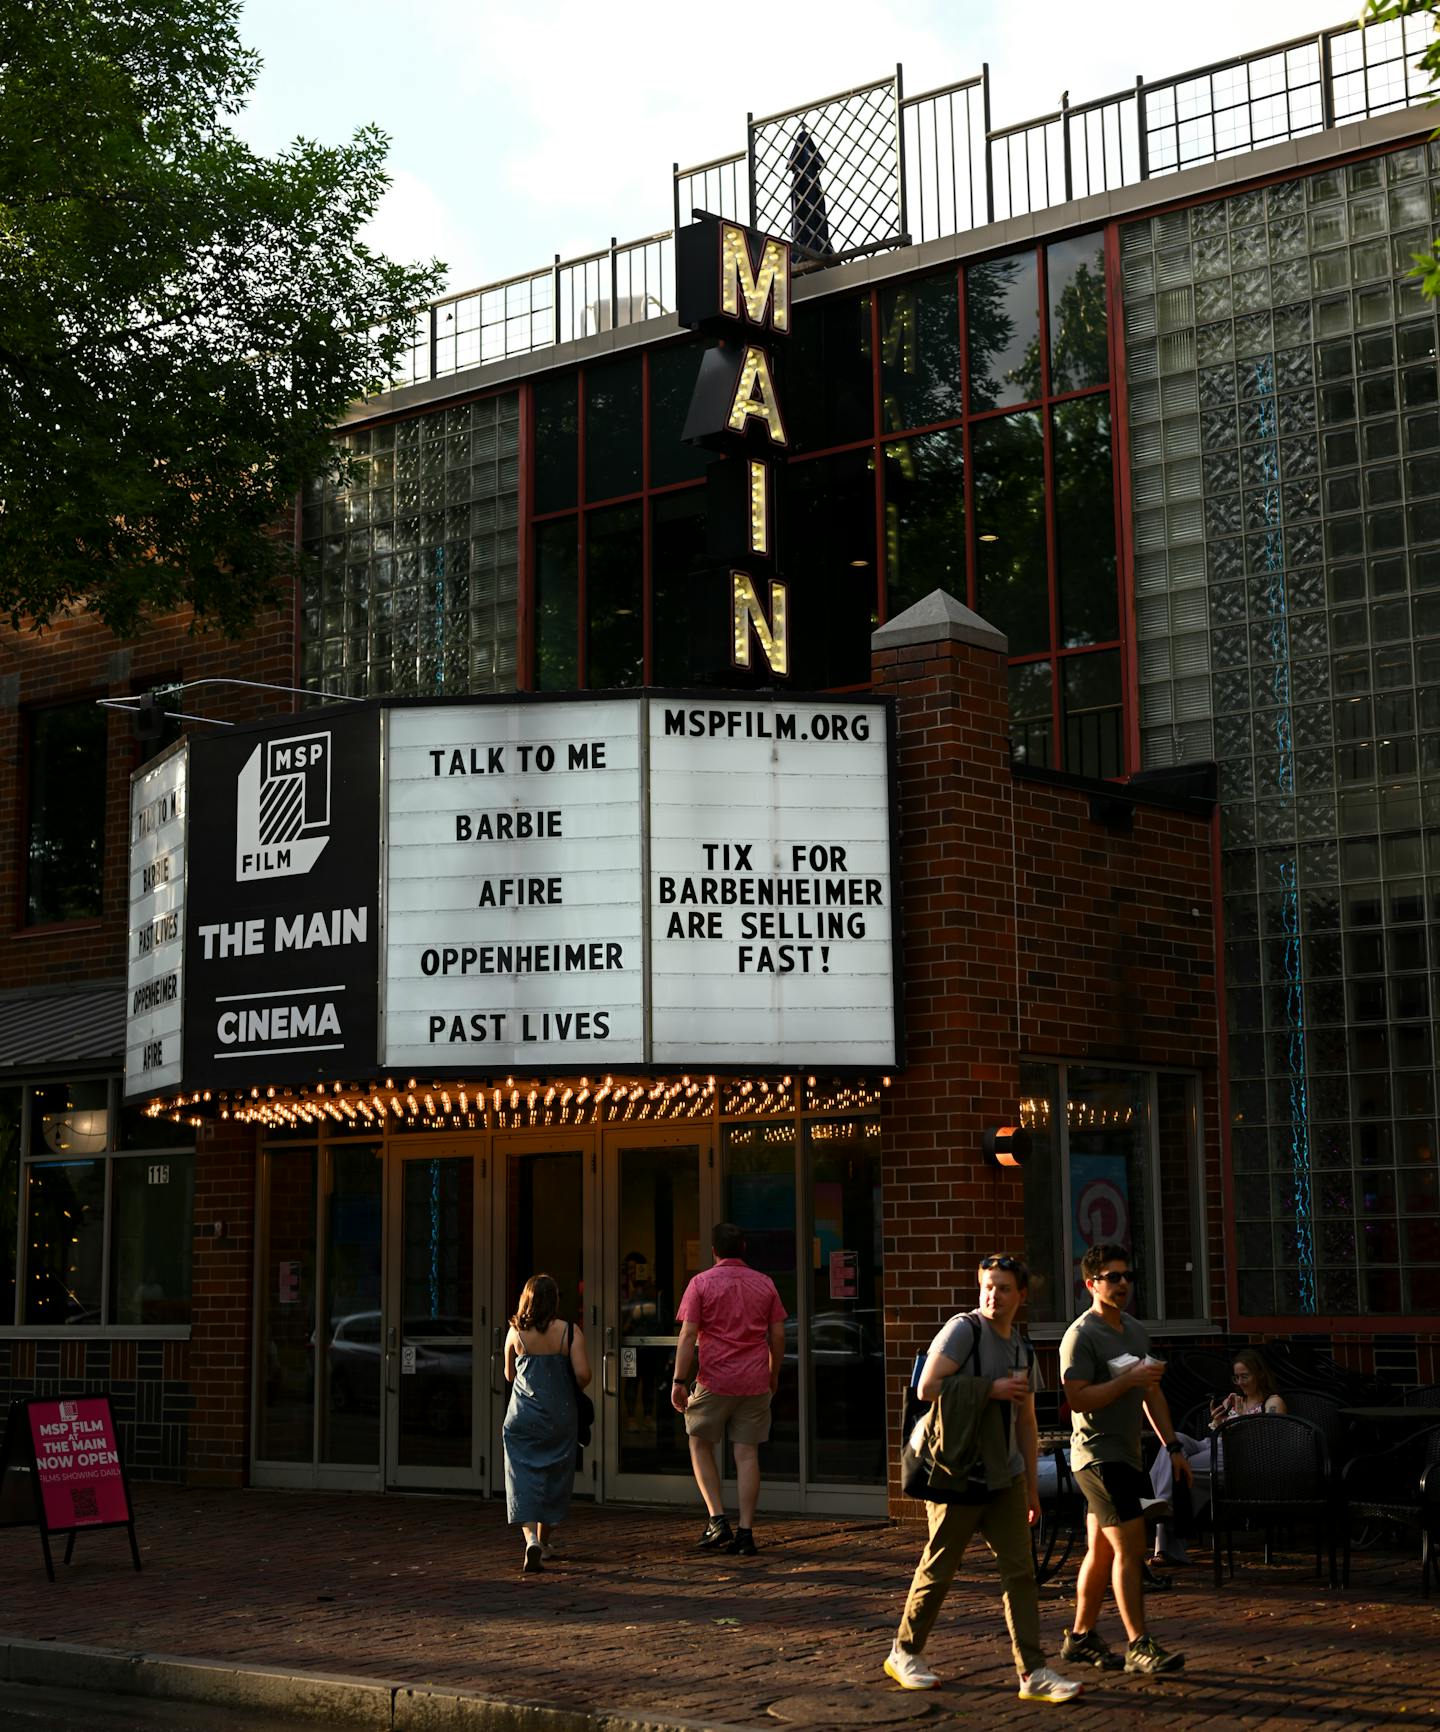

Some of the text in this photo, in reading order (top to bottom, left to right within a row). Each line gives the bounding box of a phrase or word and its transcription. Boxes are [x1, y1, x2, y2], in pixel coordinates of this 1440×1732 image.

[719, 220, 792, 678] MAIN
[664, 709, 870, 741] MSPFILM.ORG
[275, 744, 323, 771] MSP
[429, 742, 606, 776] TALK TO ME
[158, 798, 167, 825] TO
[456, 811, 562, 841] BARBIE
[242, 849, 291, 873] FILM
[702, 844, 848, 873] TIX FOR
[143, 857, 169, 893] BARBIE
[478, 877, 562, 907] AFIRE
[659, 877, 883, 905] BARBENHEIMER
[139, 913, 178, 954] PAST LIVES
[198, 906, 368, 960] THE MAIN
[666, 911, 866, 939] ARE SELLING
[420, 943, 624, 976] OPPENHEIMER
[738, 945, 830, 973] FAST!
[133, 974, 177, 1015] OPPENHEIMER
[216, 1002, 342, 1045] CINEMA
[429, 1012, 610, 1043] PAST LIVES
[143, 1041, 163, 1071] AFIRE
[39, 1419, 104, 1436] MSP FILM
[68, 1433, 79, 1441] AT
[43, 1437, 107, 1454] THE MAIN
[36, 1451, 119, 1471] NOW OPEN
[62, 1469, 100, 1481] SHOWING
